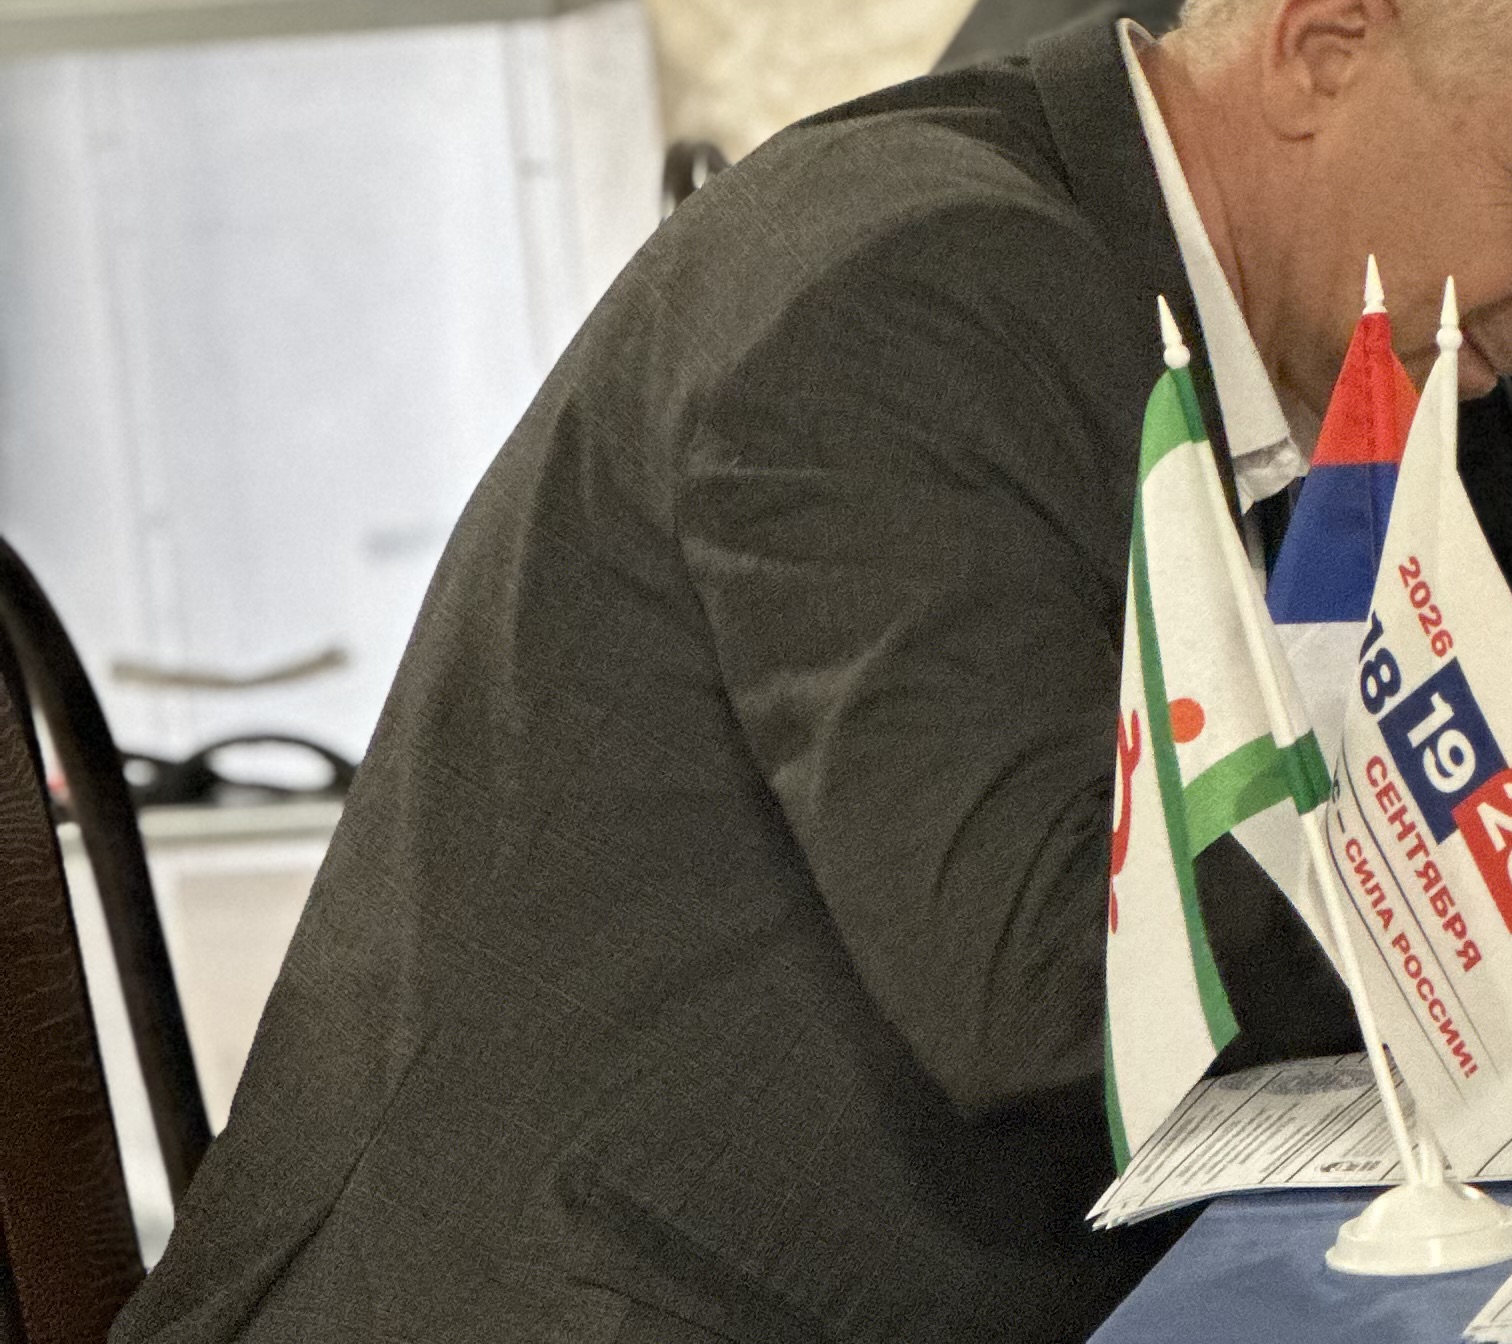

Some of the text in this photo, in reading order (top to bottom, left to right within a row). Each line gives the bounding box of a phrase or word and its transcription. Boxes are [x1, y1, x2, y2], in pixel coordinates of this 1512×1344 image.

[1359, 609, 1402, 715] 18
[1407, 692, 1476, 794] 19
[1398, 556, 1455, 658] 2026
[1344, 837, 1395, 932] СИЛА
[1392, 931, 1480, 1079] РОССИИ!
[1365, 755, 1482, 973] СЕНТЯБРЯ
